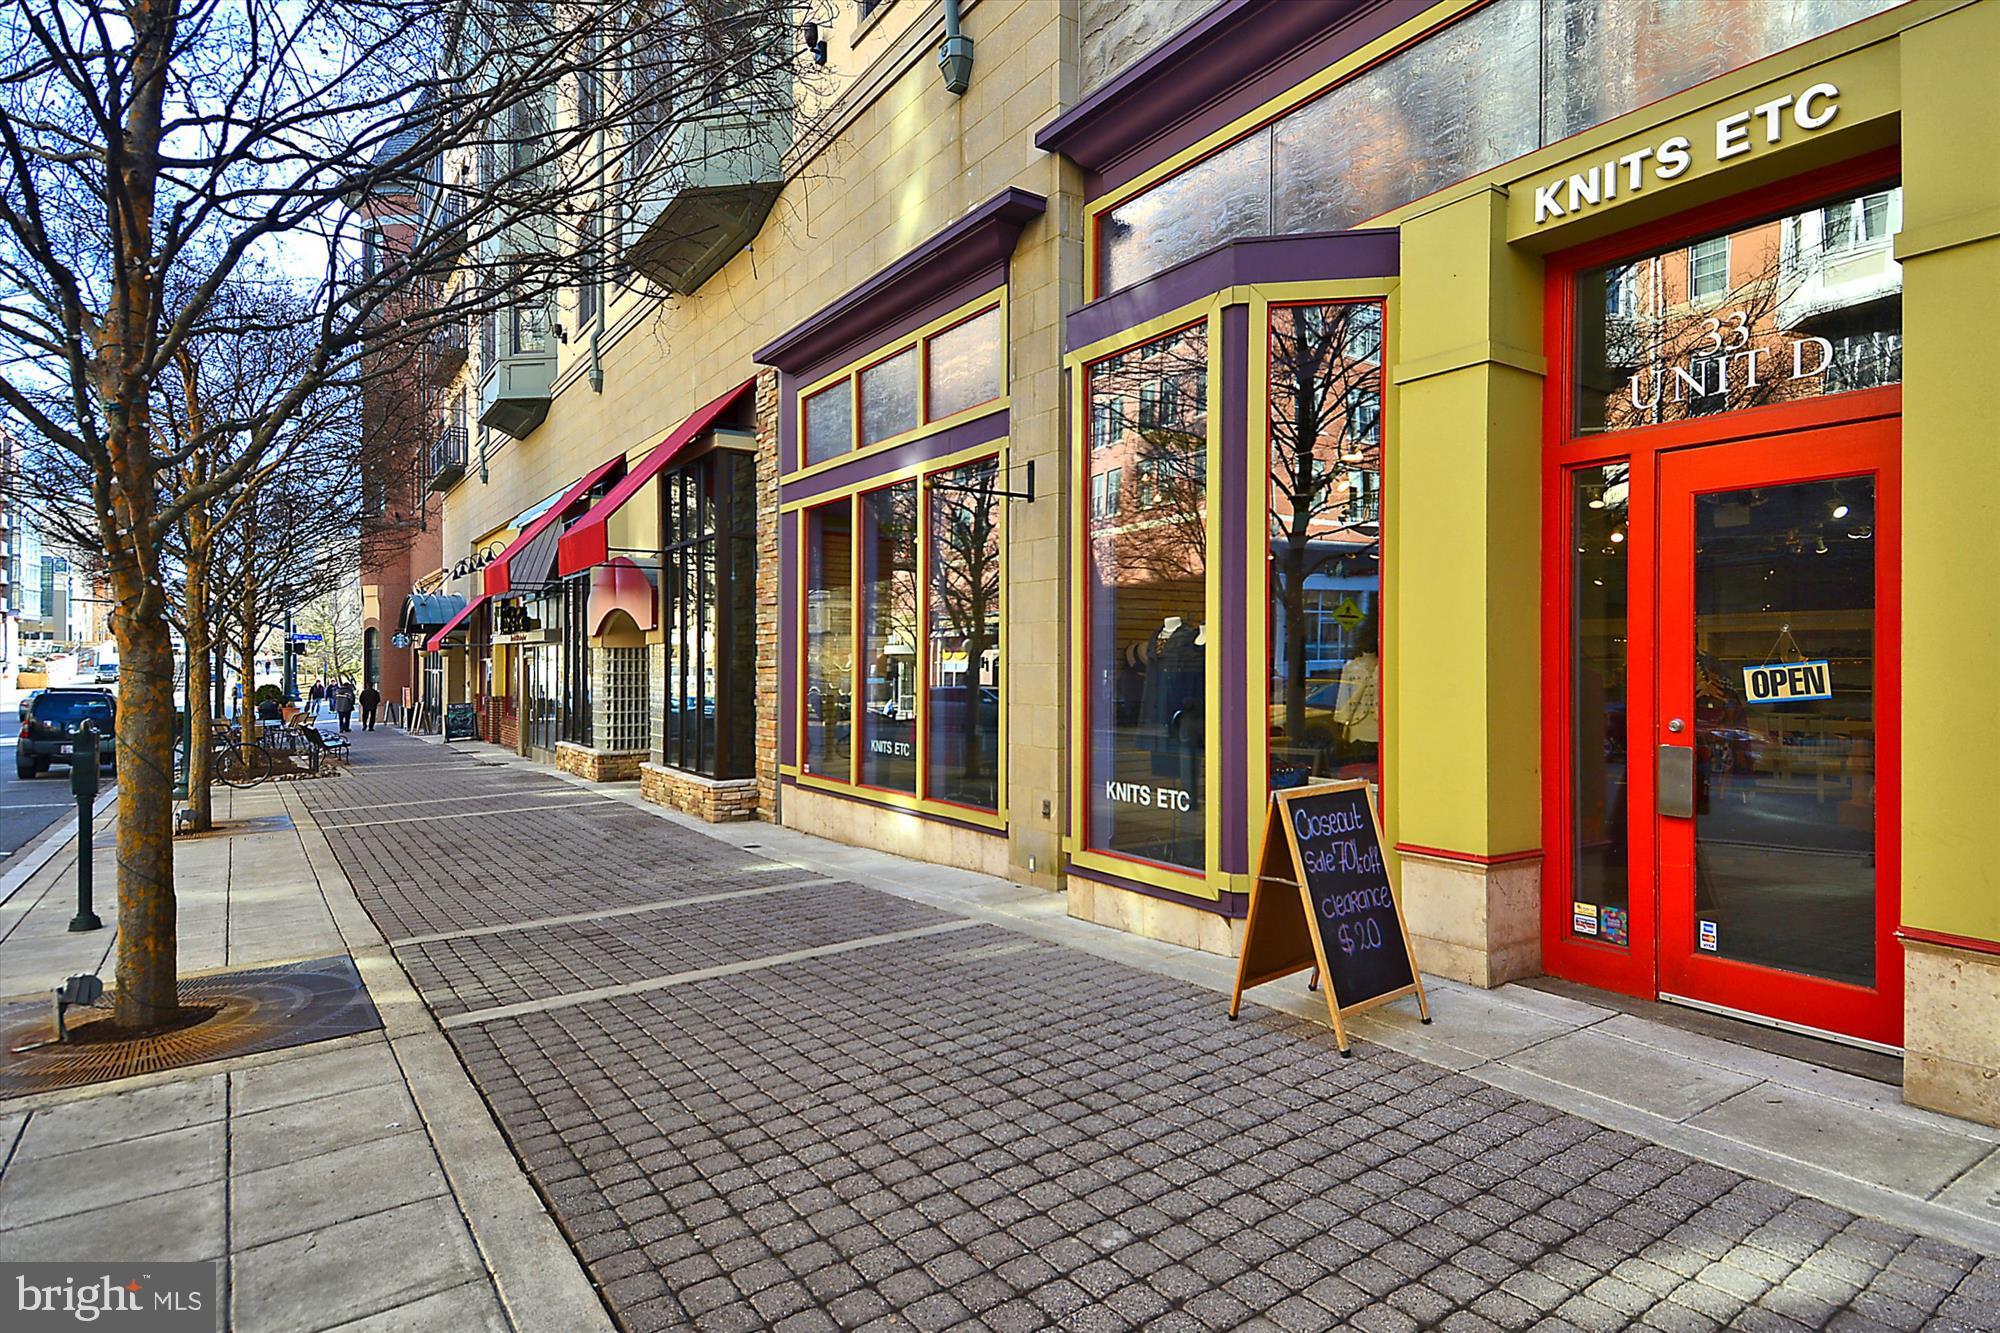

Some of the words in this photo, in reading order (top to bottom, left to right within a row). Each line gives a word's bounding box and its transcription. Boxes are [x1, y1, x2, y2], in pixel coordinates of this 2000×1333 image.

[1534, 136, 1692, 224] KNITS
[1715, 82, 1840, 161] ETC
[1698, 311, 1750, 357] 33
[1627, 347, 1770, 410] UNIT
[1788, 336, 1834, 381] D
[1752, 665, 1826, 699] OPEN
[870, 739, 893, 754] KNITS
[894, 742, 910, 756] ETC
[1106, 780, 1151, 806] KNITS
[1157, 787, 1190, 812] ETC
[1294, 803, 1364, 840] Closeout
